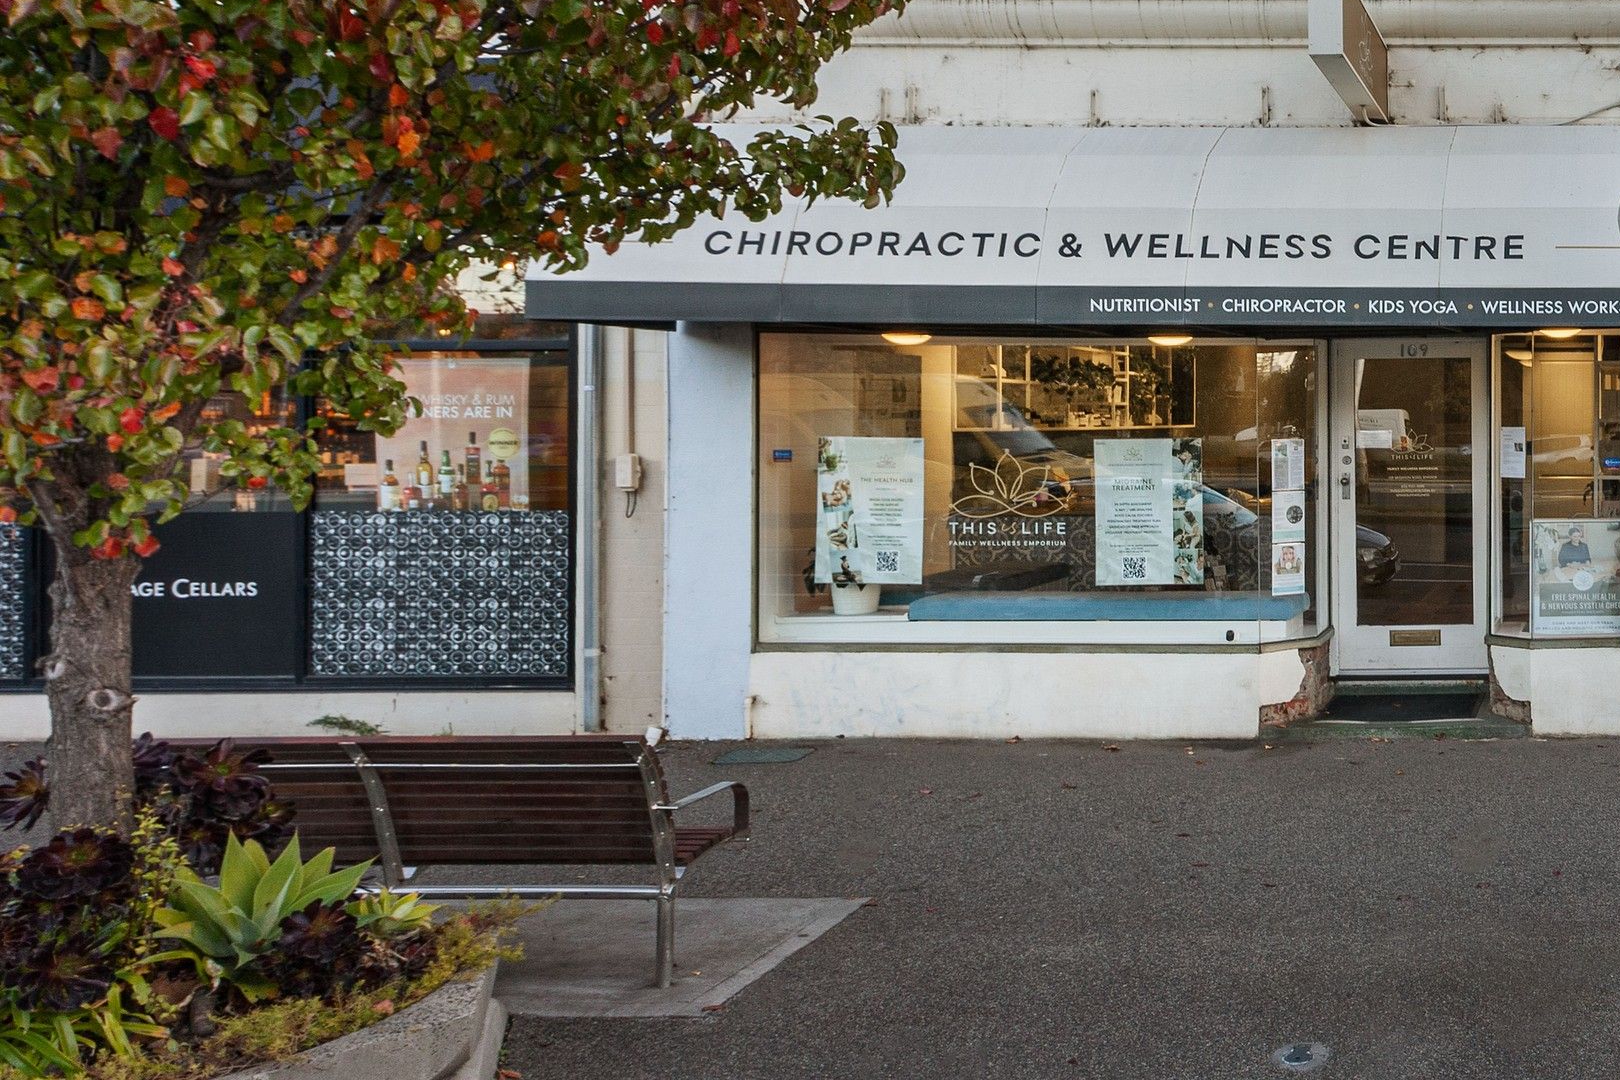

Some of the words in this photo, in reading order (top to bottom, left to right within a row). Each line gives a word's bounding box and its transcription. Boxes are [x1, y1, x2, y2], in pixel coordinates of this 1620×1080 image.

[704, 230, 1041, 258] CHIROPRACTIC
[1058, 232, 1083, 258] &
[1104, 233, 1332, 260] WELLNESS
[1354, 234, 1525, 260] CENTRE
[1090, 298, 1200, 313] NUTRITIONIST
[1222, 298, 1346, 314] CHIROPRACTOR
[1368, 300, 1405, 314] KIDS
[1408, 300, 1458, 315] YOGA
[1481, 300, 1563, 315] WELLNESS
[486, 394, 515, 406] RUM
[464, 406, 491, 418] ARE
[496, 406, 513, 418] IN
[949, 522, 997, 535] THIS
[1001, 517, 1017, 535] is
[1022, 522, 1067, 535] LIFE
[171, 578, 258, 598] CELLARS
